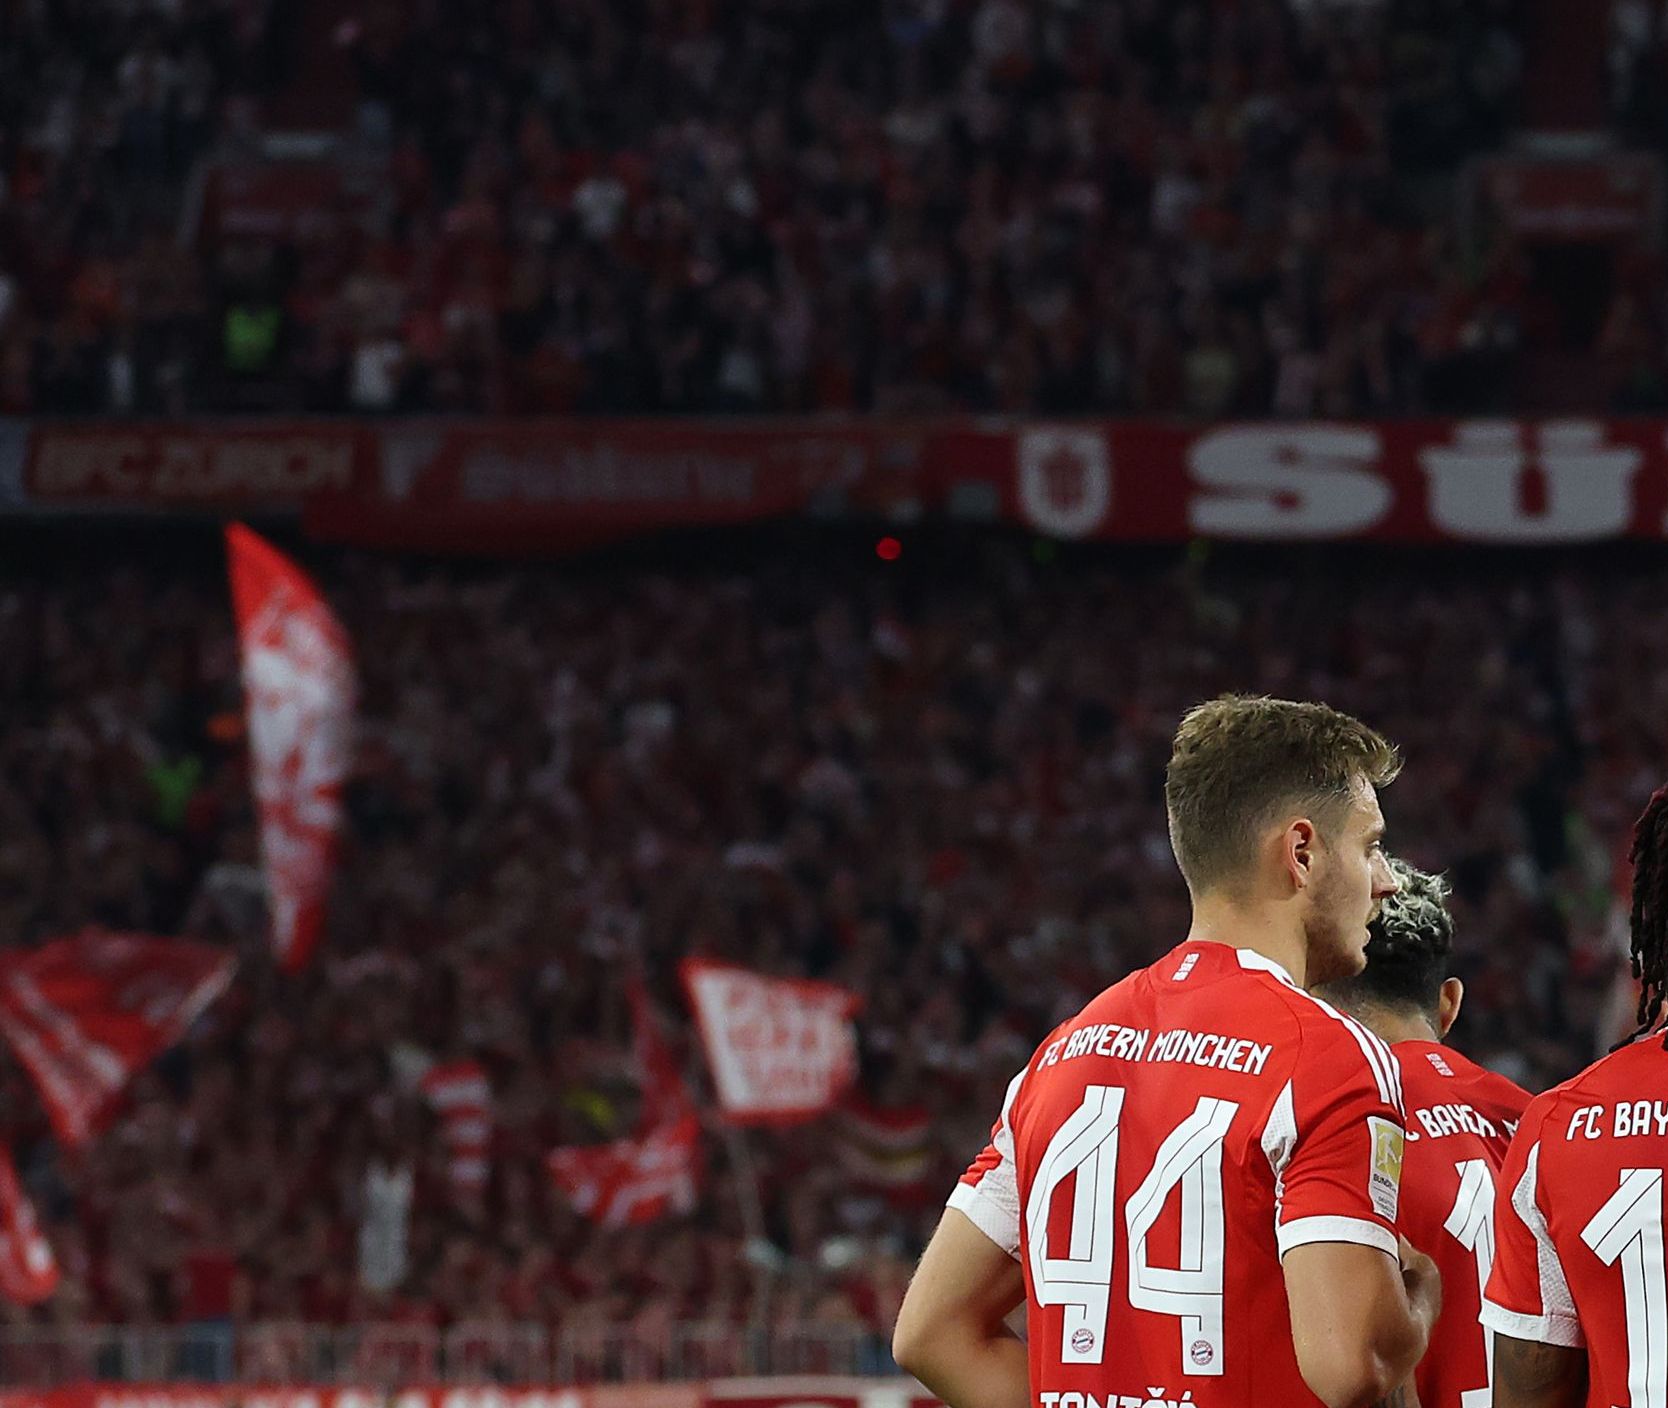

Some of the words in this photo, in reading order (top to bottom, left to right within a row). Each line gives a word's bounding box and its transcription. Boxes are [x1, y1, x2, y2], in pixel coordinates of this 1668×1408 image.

[1036, 1030, 1063, 1071] FC
[1060, 1023, 1150, 1063] BAYERN
[1147, 1029, 1274, 1076] MÜNCHEN
[1566, 1104, 1604, 1141] FC
[1026, 1084, 1240, 1376] 44
